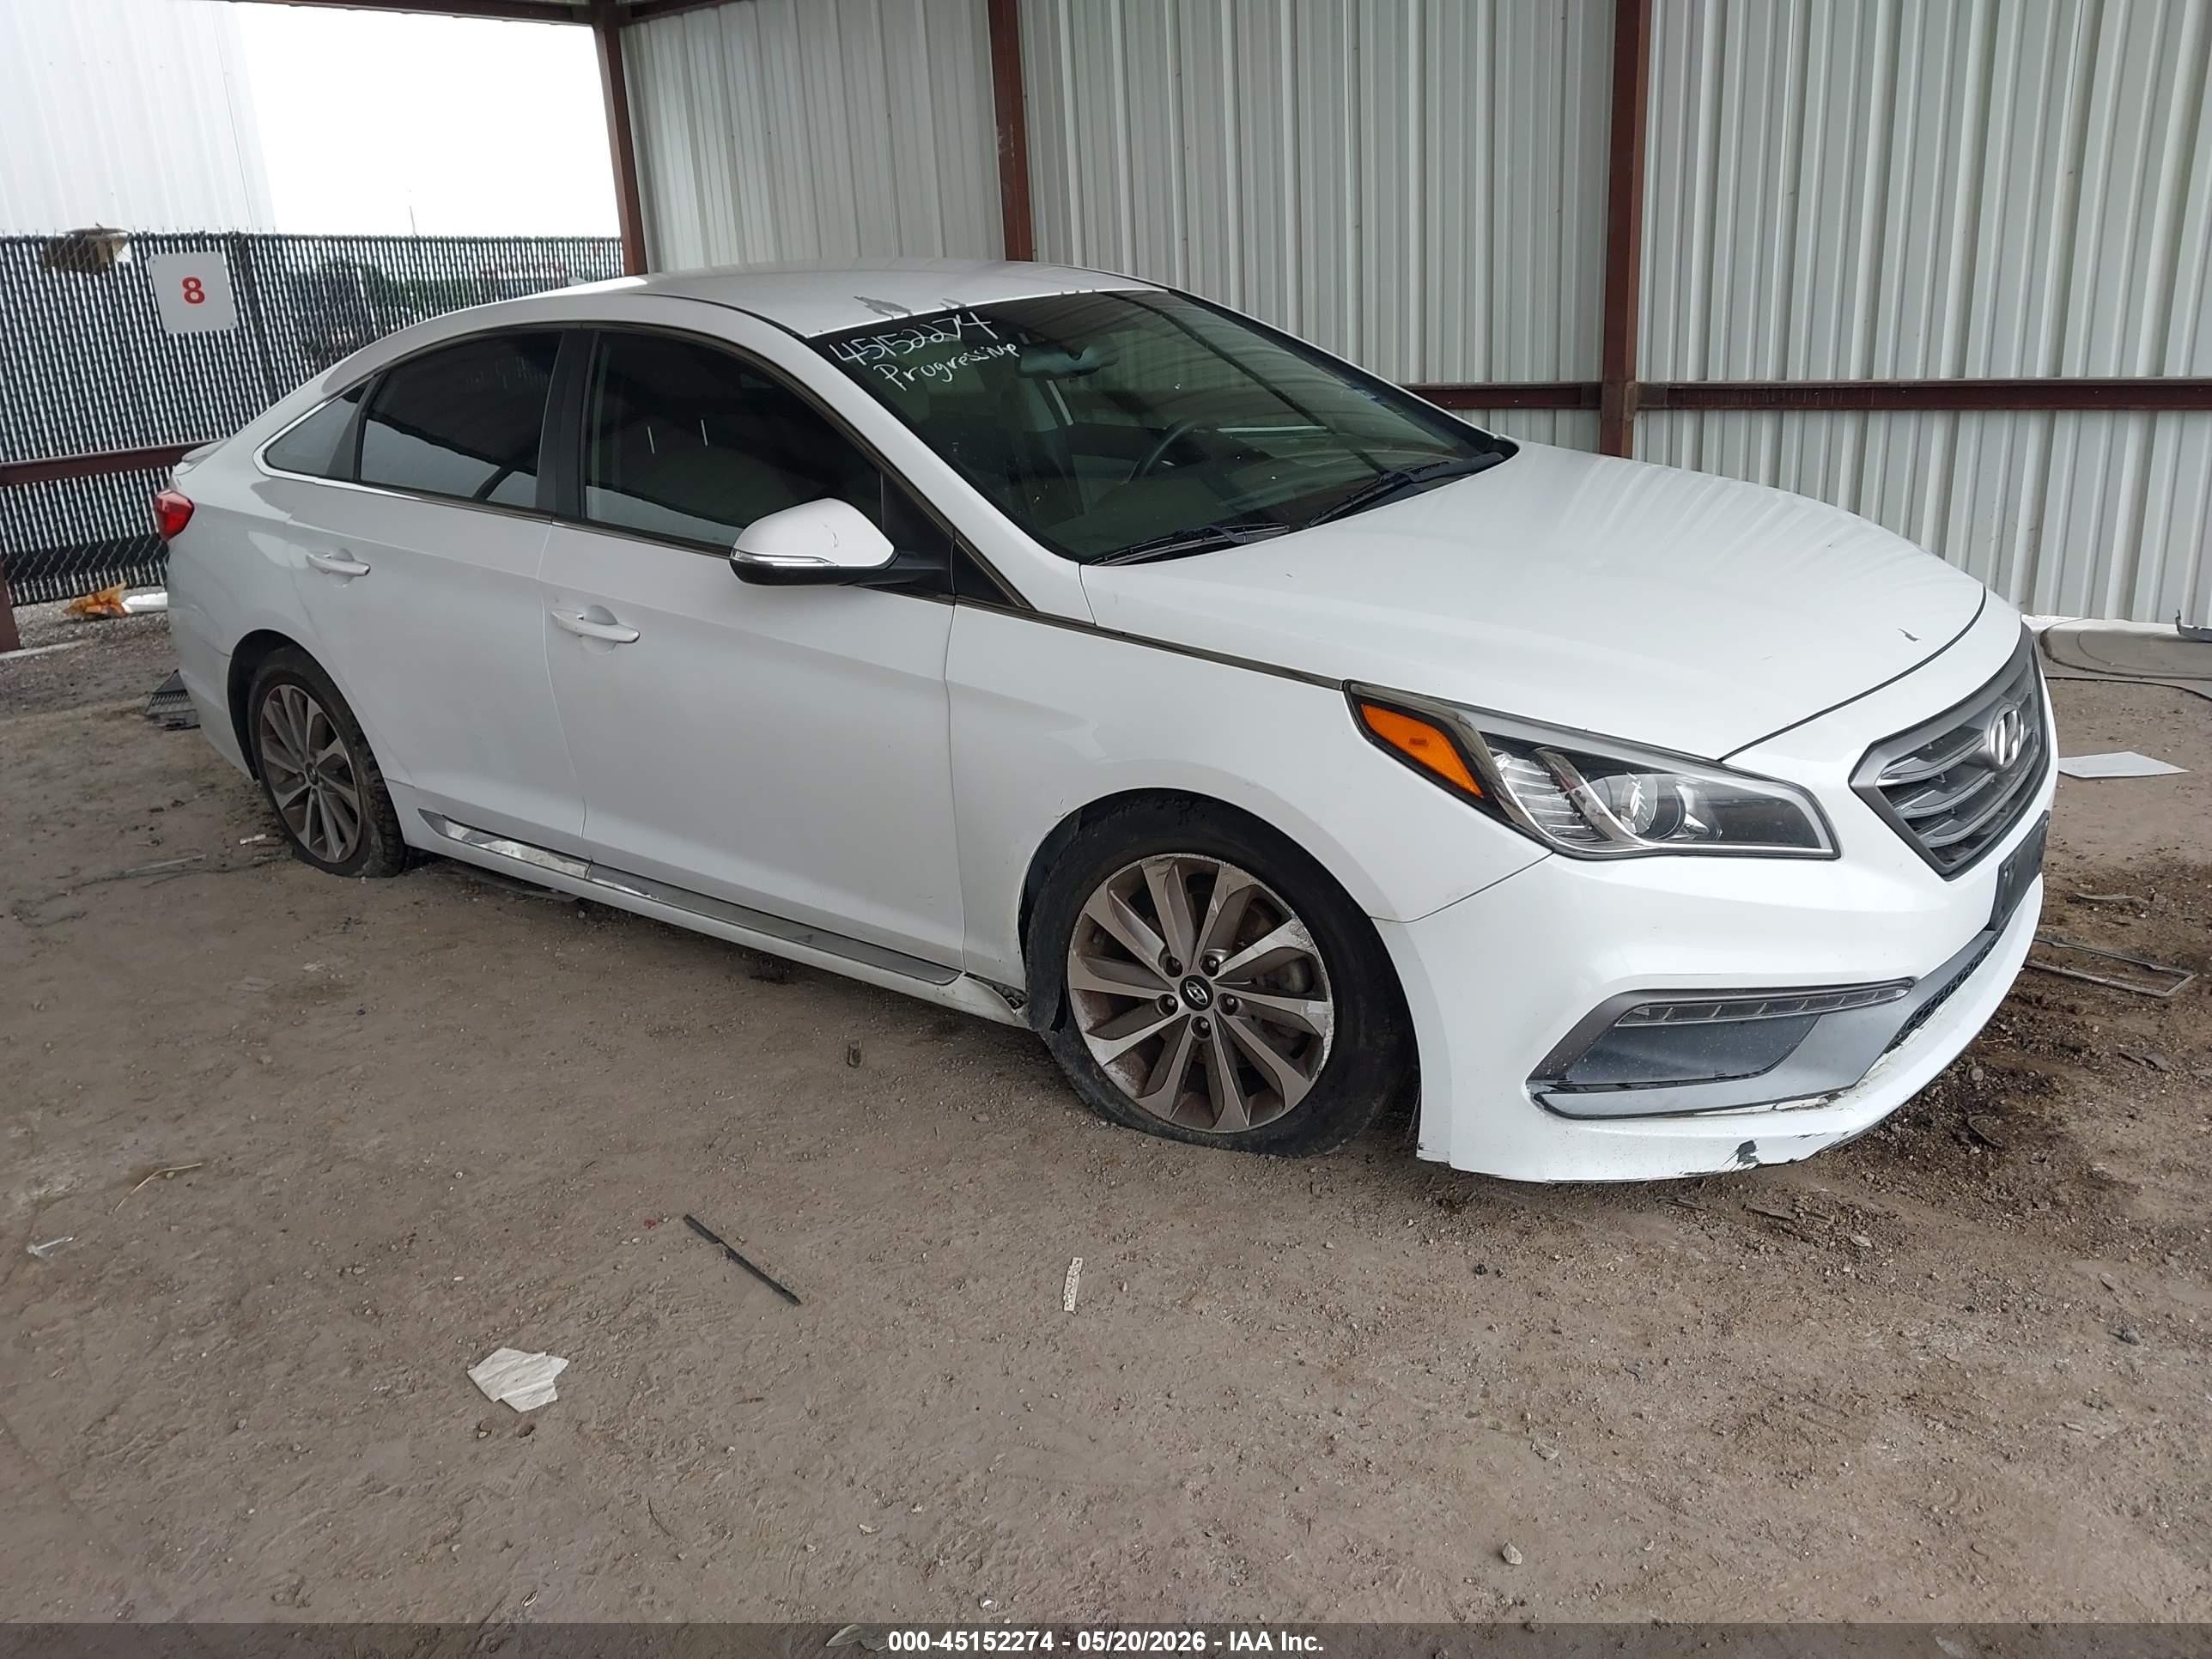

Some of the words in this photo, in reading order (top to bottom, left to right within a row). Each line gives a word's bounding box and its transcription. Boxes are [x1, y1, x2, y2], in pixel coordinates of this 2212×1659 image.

[180, 276, 206, 305] 8
[828, 311, 999, 367] 45152274
[872, 342, 1020, 392] Progressive
